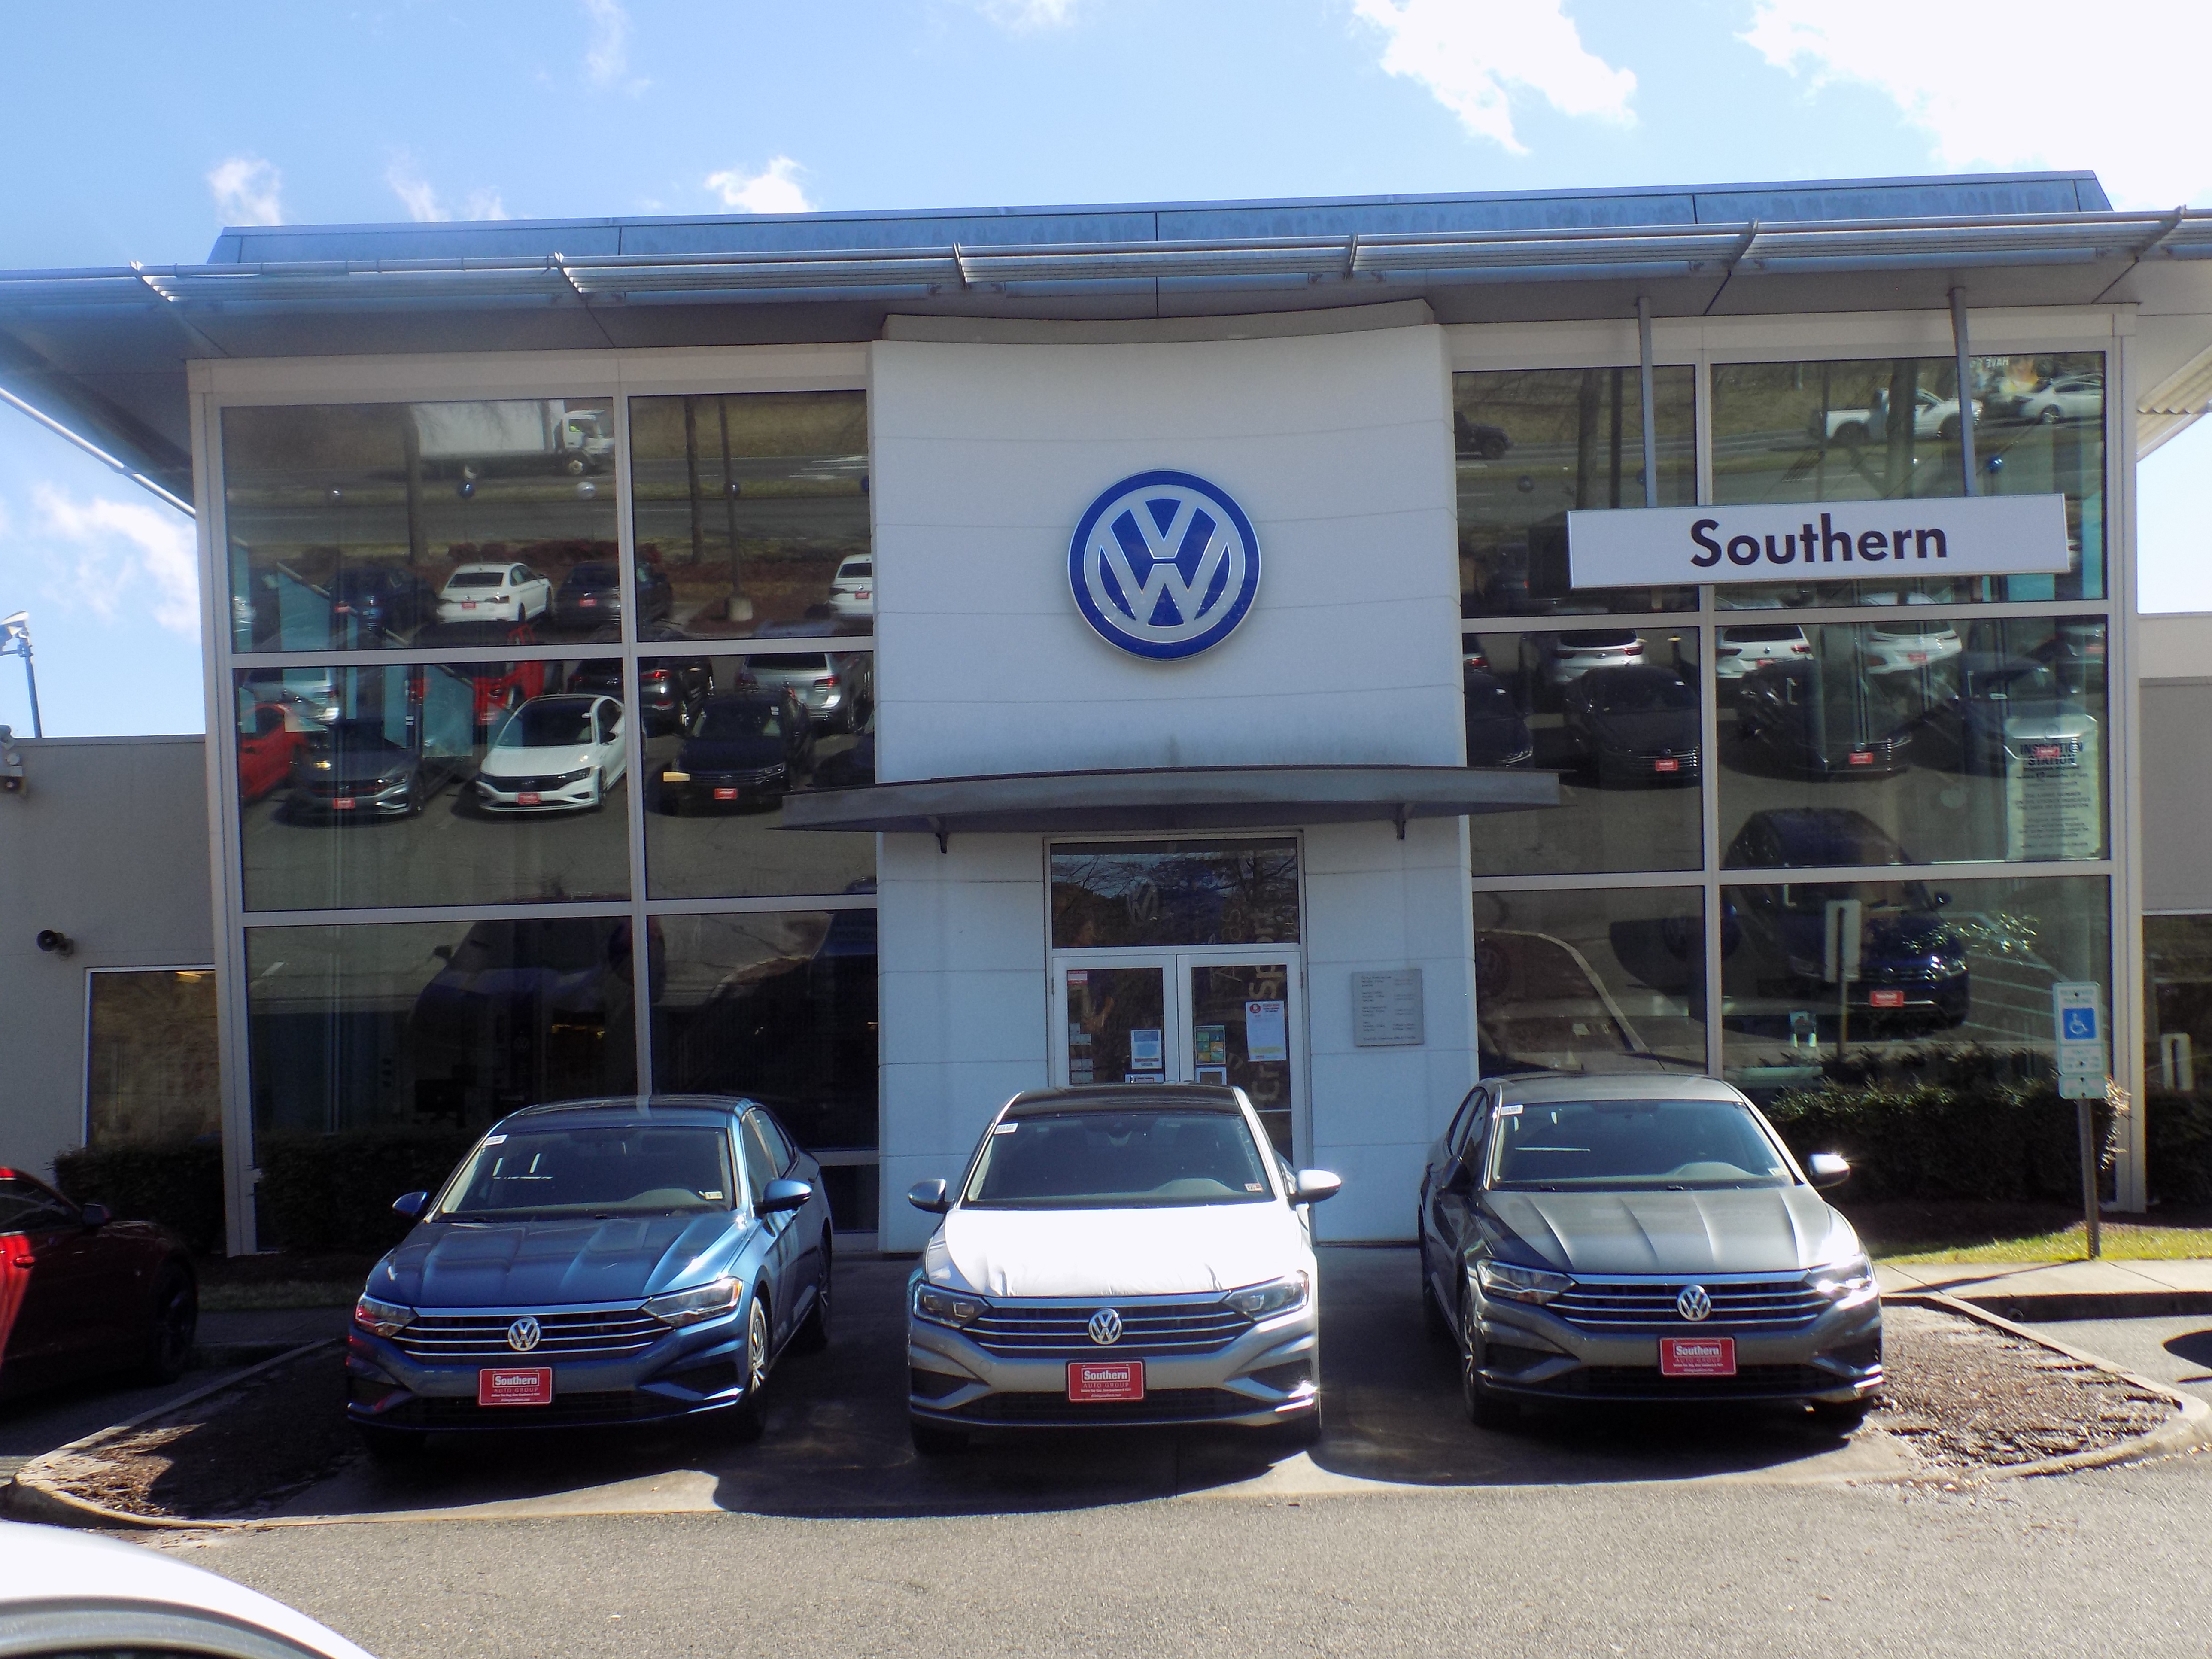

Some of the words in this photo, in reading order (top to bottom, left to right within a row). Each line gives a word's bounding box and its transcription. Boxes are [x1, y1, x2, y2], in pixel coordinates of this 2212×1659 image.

[1691, 513, 1948, 568] Southern
[2020, 742, 2083, 755] INSTION
[1676, 1346, 1719, 1355] Southern
[495, 1375, 537, 1385] Southern
[1084, 1370, 1127, 1380] Southern
